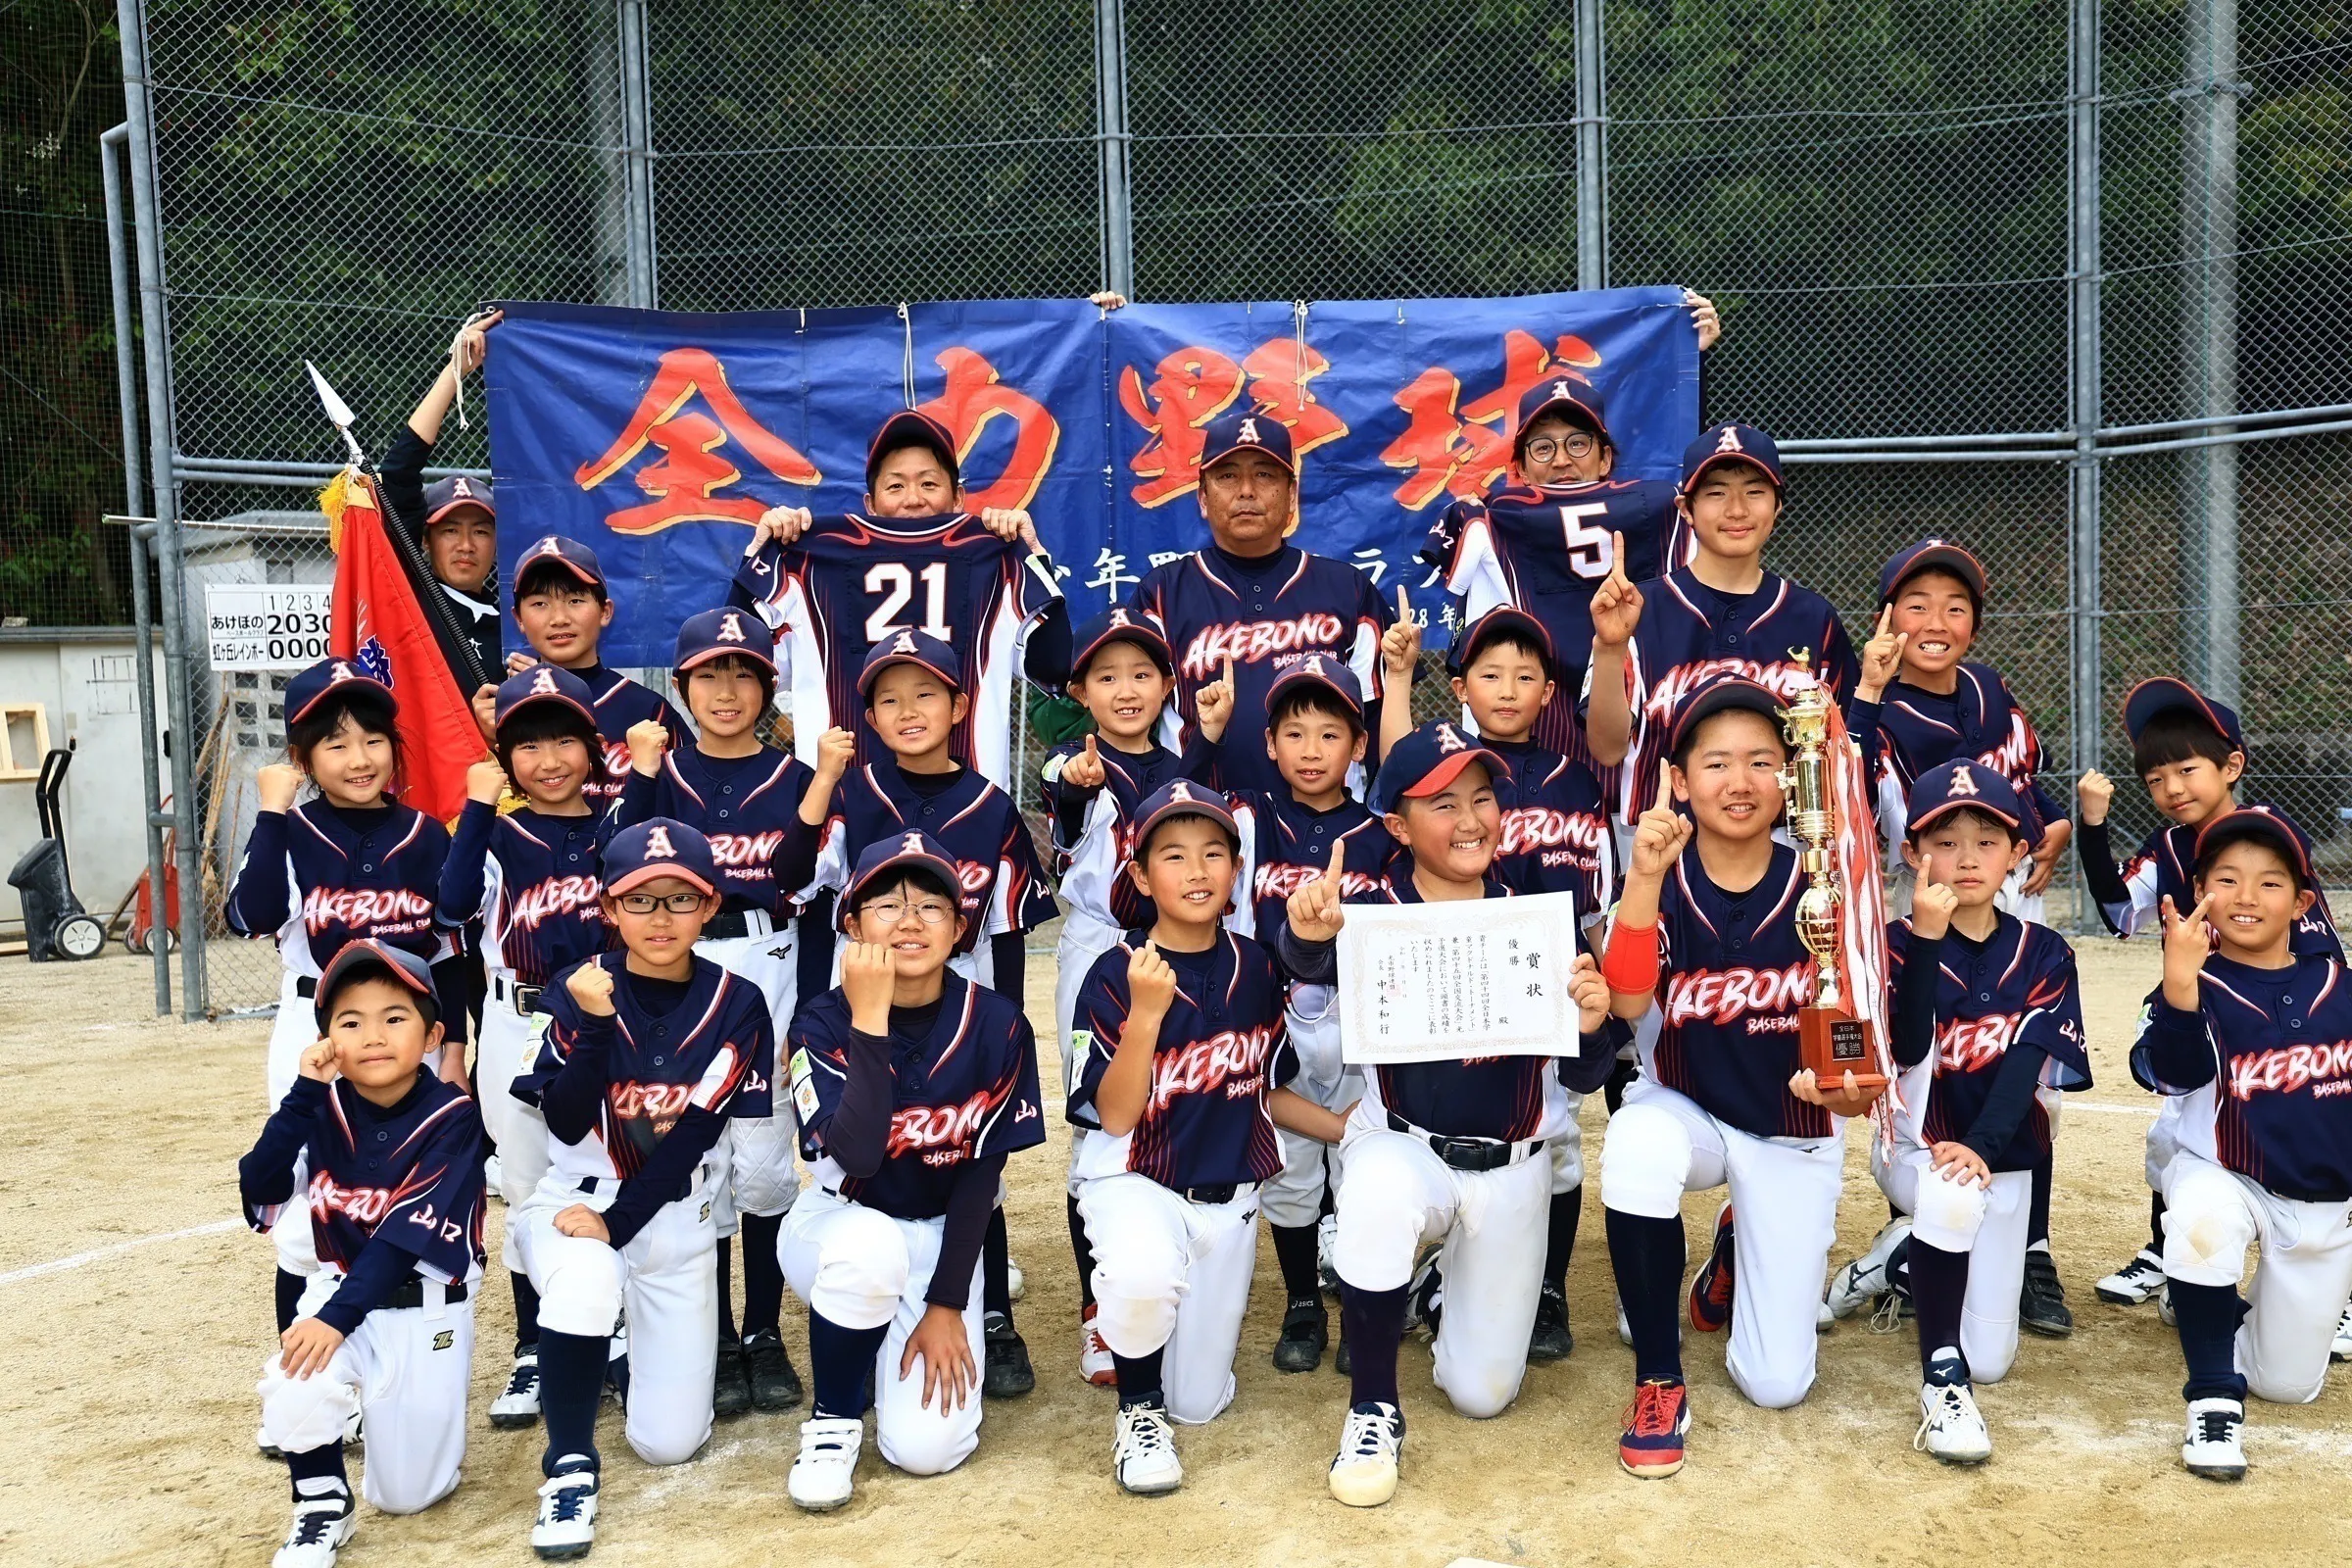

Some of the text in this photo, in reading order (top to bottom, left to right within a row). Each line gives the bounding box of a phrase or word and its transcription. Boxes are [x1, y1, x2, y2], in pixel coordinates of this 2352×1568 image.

[1549, 381, 1575, 400] A
[1236, 417, 1262, 444] A
[1715, 425, 1743, 454] A
[452, 477, 472, 498] A
[540, 536, 564, 556] A
[1559, 502, 1613, 578] 5
[270, 594, 331, 611] 1 2 3 4
[864, 562, 953, 645] 21
[212, 613, 264, 629] あけぼの
[267, 614, 283, 635] 2
[285, 613, 301, 634] 0
[304, 613, 320, 633] 3
[716, 612, 747, 642] A
[1109, 608, 1131, 632] A
[269, 640, 285, 660] 0
[287, 638, 304, 659] 0
[306, 638, 321, 658] 0
[891, 630, 919, 656] A
[1181, 612, 1344, 681] AKEBONO
[330, 661, 355, 686] A
[1302, 655, 1327, 677] A
[530, 667, 561, 695] A
[1436, 722, 1467, 754] A
[1170, 781, 1193, 804] A
[1947, 765, 1980, 798] A
[644, 826, 677, 860] A
[899, 832, 925, 856] A
[724, 867, 765, 881] BASEBALL
[304, 886, 432, 937] AKEBONO
[370, 922, 414, 936] BASEBALL
[1508, 938, 1520, 966] 優勝
[1526, 953, 1544, 998] 賞状
[1377, 979, 1390, 1035] 中本和行
[1836, 1042, 1861, 1056] 優勝
